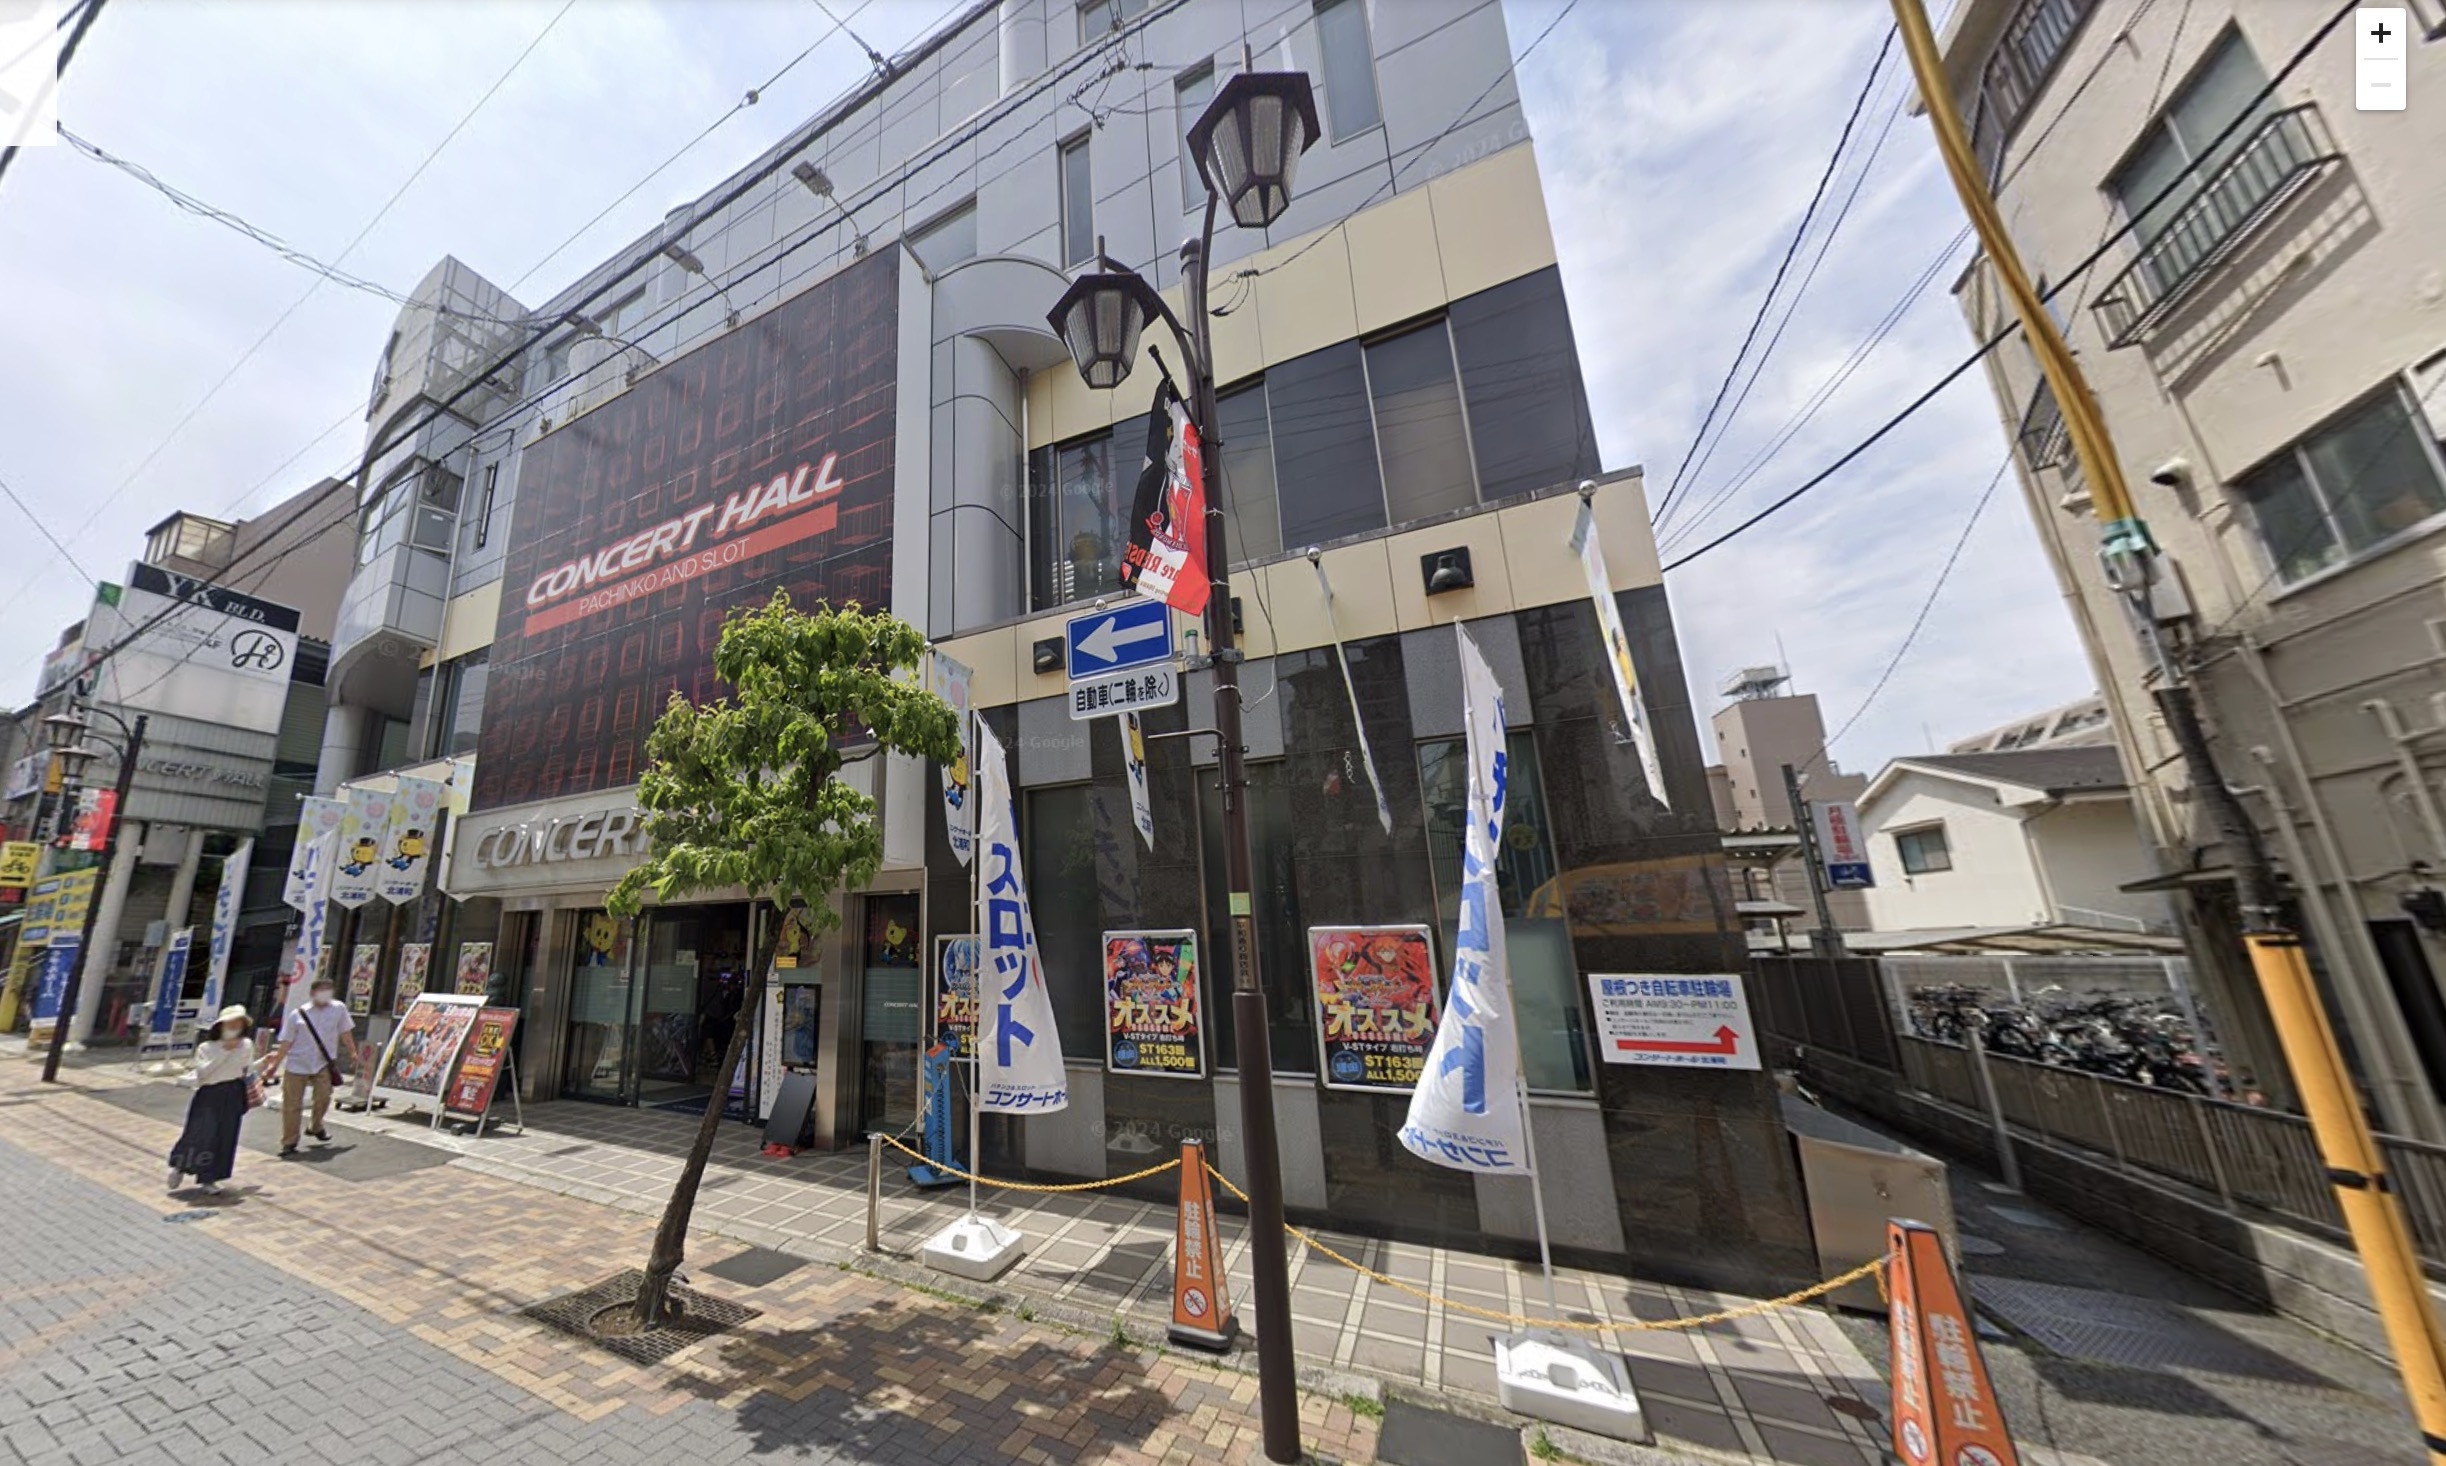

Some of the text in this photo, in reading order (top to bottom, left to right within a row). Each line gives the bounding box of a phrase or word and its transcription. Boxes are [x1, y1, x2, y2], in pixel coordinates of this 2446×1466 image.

[526, 453, 844, 605] CONCERT HALL
[579, 538, 751, 615] PACHINKO AND SLOT
[224, 600, 266, 624] BLD.
[1076, 672, 1170, 712] 自動車(二輪を除く)
[986, 842, 1035, 1067] スロット
[1601, 978, 1733, 998] 屋根つき自転車駐輪場
[1113, 996, 1195, 1033] オススメ
[1327, 1000, 1436, 1039] オススメ
